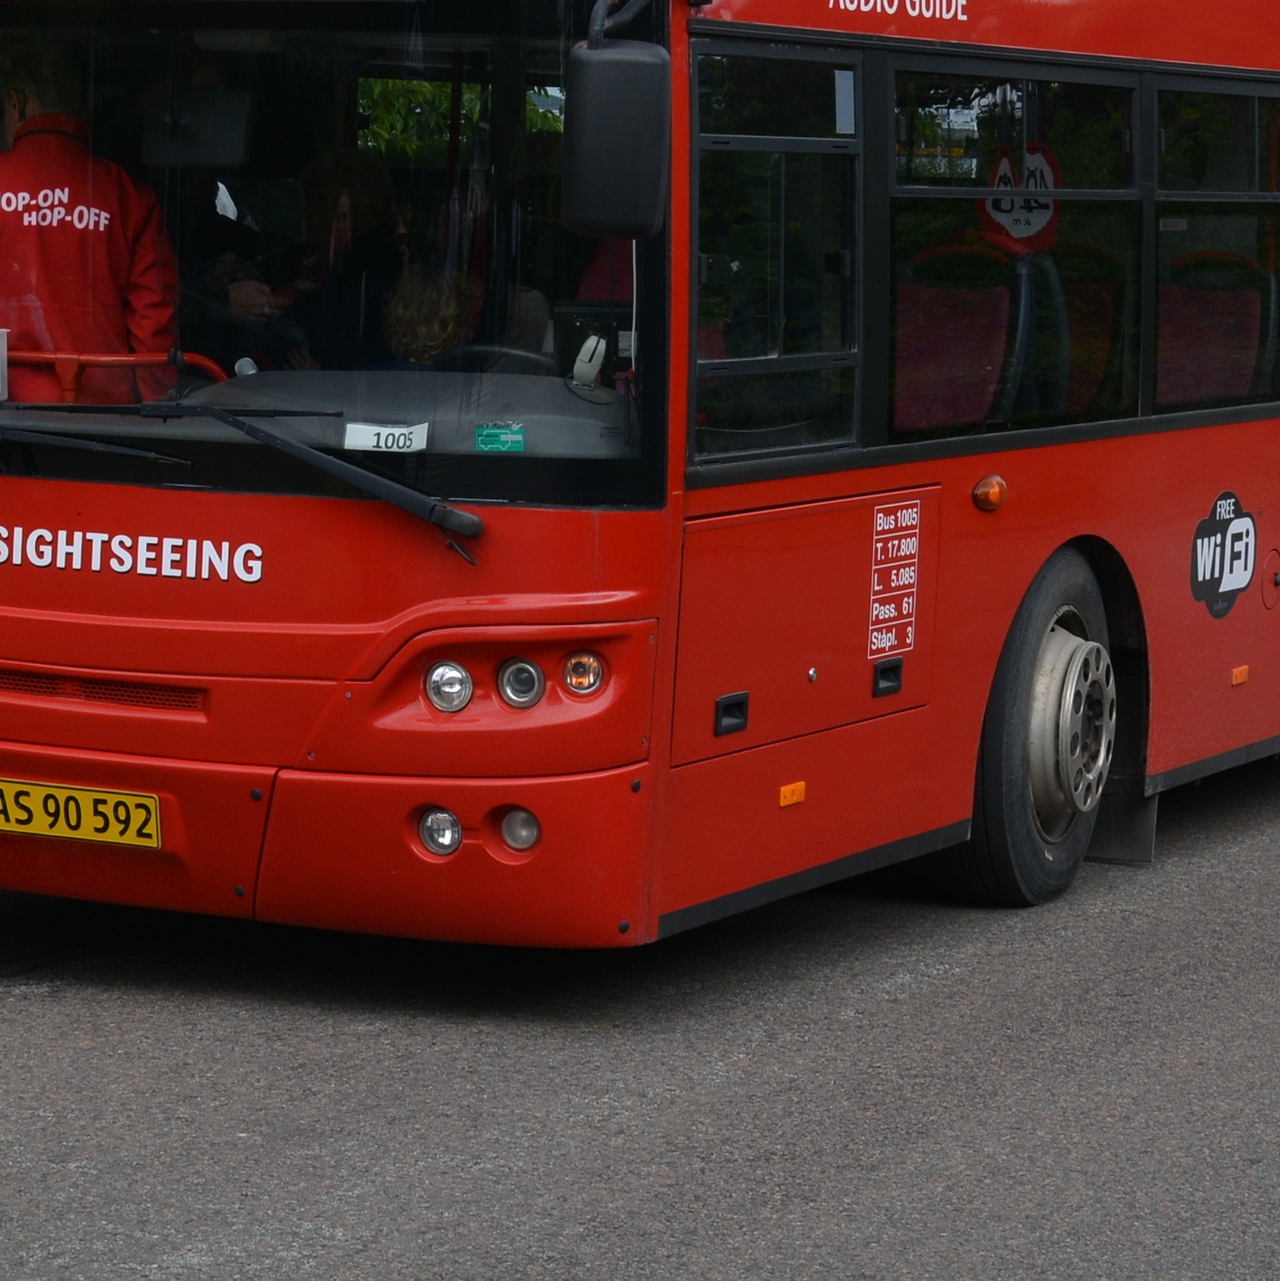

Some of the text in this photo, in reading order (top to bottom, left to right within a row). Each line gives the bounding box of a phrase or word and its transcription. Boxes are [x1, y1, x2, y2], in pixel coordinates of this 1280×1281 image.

[23, 205, 110, 231] HOP-OFF
[372, 430, 413, 450] 1005
[876, 508, 918, 531] Bus 1005
[1216, 498, 1235, 520] FREE
[876, 536, 917, 560] T. 17.800
[874, 566, 915, 590] L. 5.085
[872, 596, 914, 621] Pass. 61
[871, 626, 913, 652] Ståpl. 3
[42, 792, 82, 831] 90
[92, 798, 153, 840] 592
